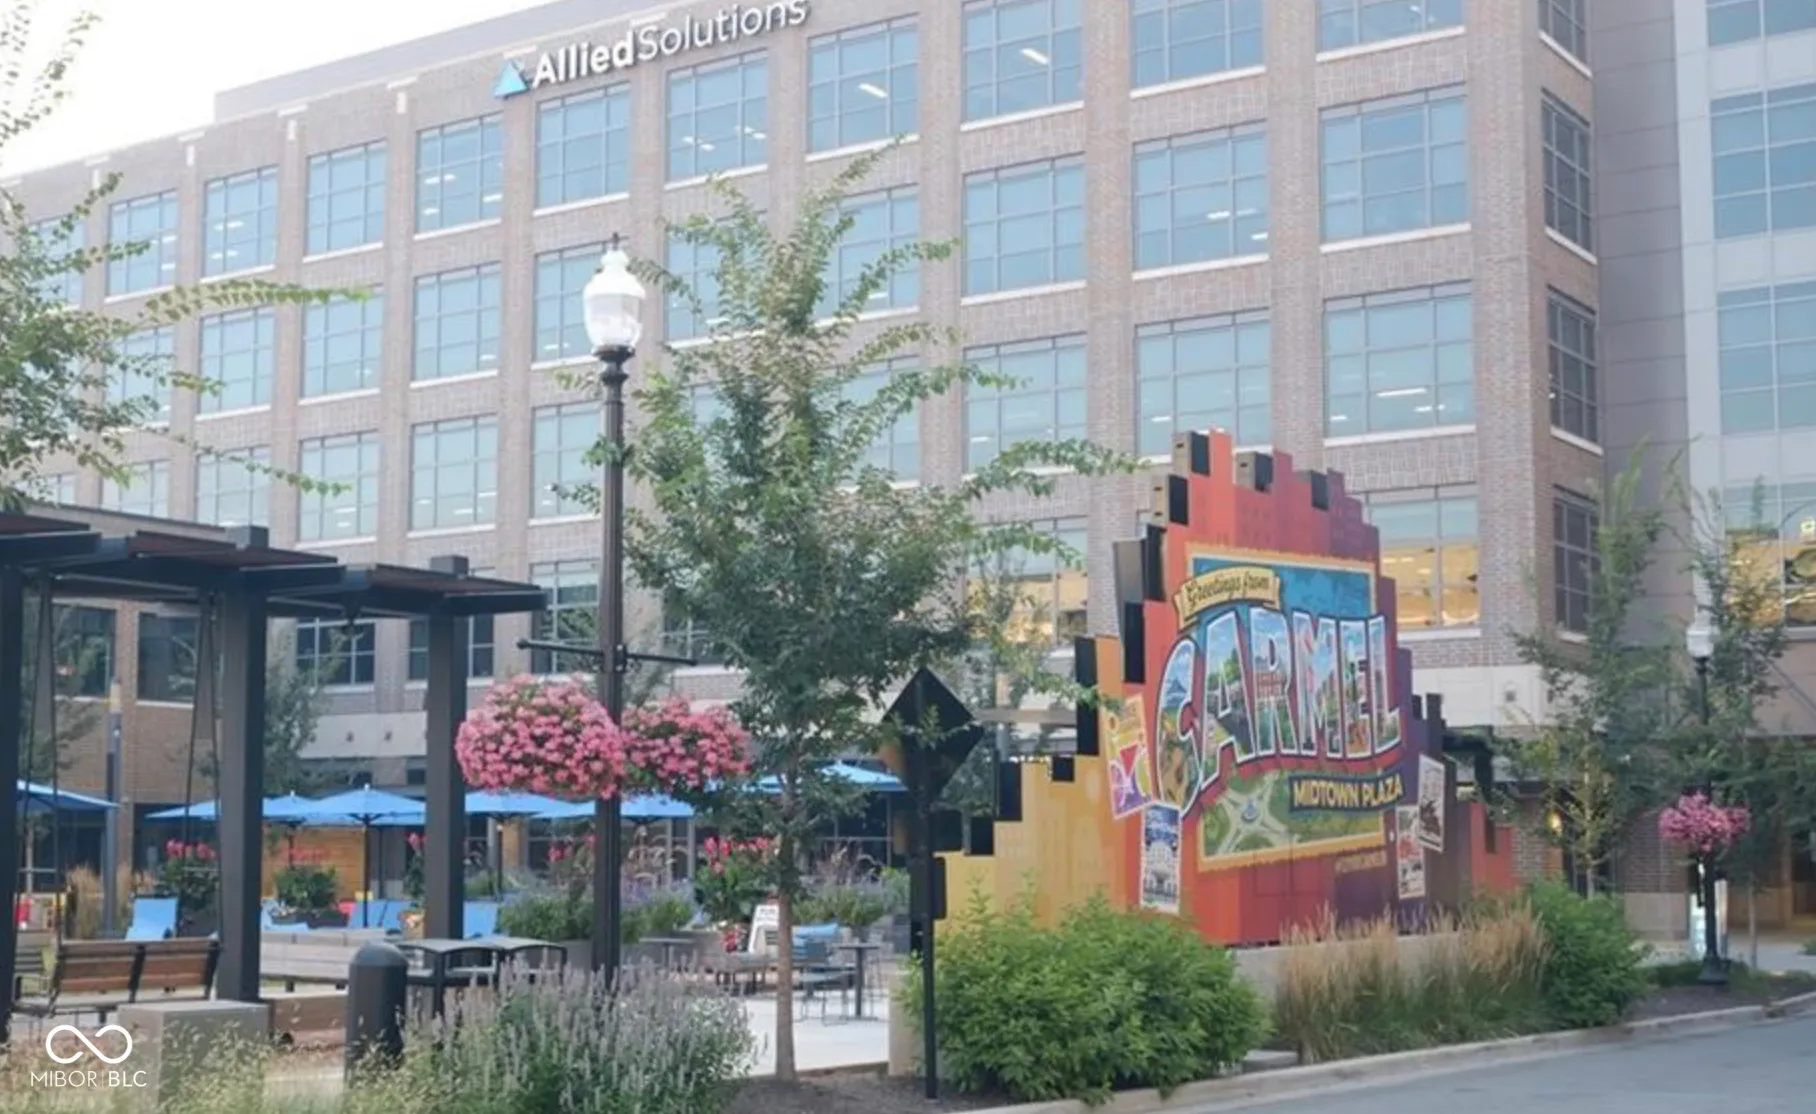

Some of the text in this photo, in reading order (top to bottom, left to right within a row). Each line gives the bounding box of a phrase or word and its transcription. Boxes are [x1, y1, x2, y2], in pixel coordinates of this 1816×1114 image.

[1156, 606, 1402, 814] CARMEL
[1293, 773, 1403, 807] MIDTOWN PLAZA
